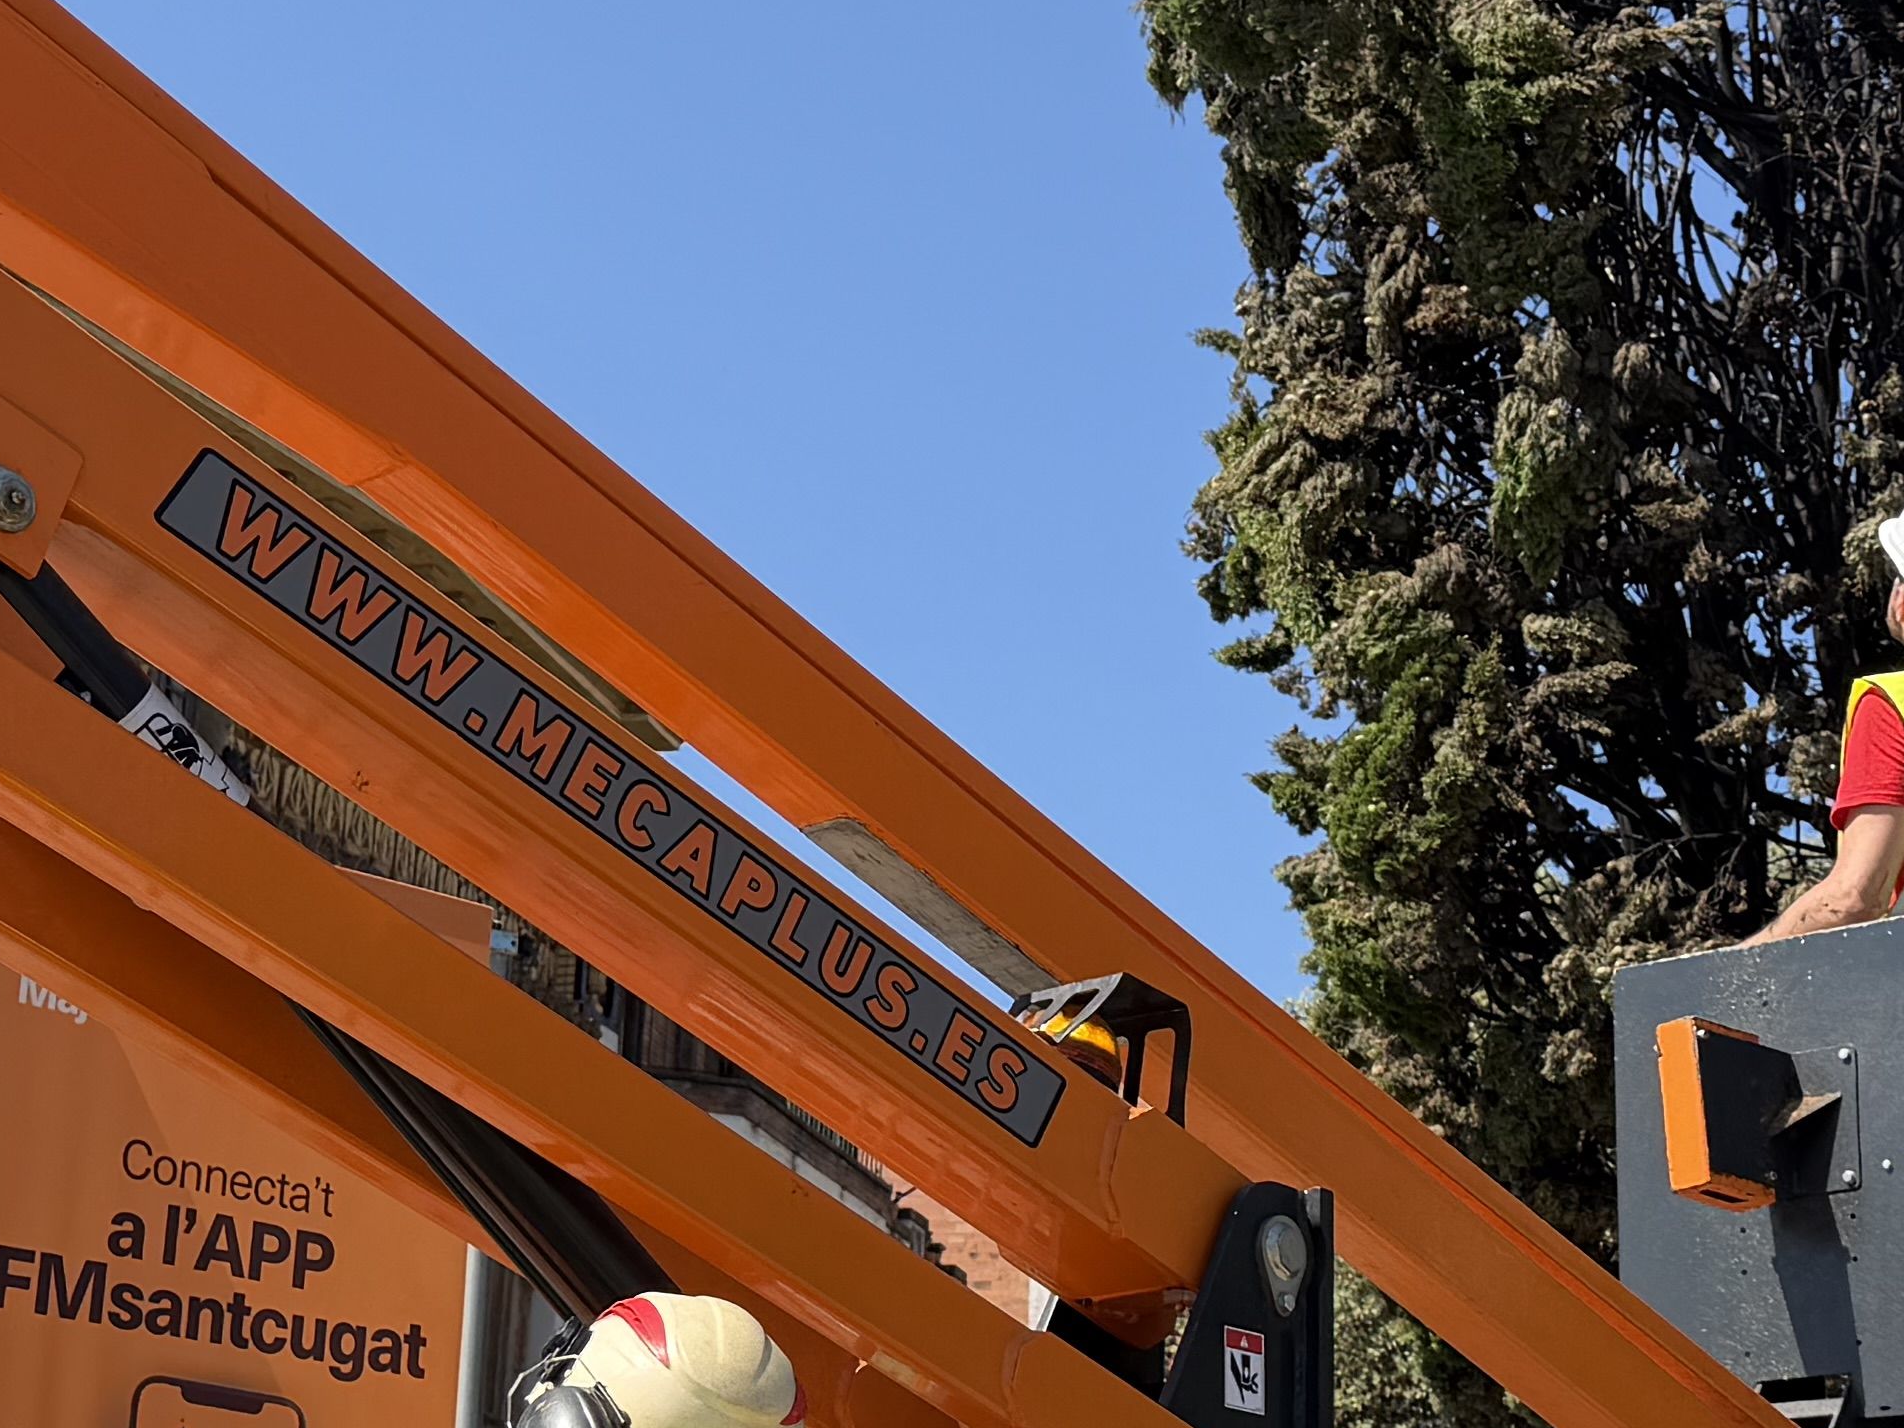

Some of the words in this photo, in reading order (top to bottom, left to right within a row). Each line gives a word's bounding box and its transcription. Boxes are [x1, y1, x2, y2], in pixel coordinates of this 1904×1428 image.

[215, 478, 1027, 1114] WWW.MECAPLUS.ES
[121, 1138, 335, 1219] Connecta't
[107, 1212, 145, 1262] a
[162, 1205, 335, 1290] l'APP
